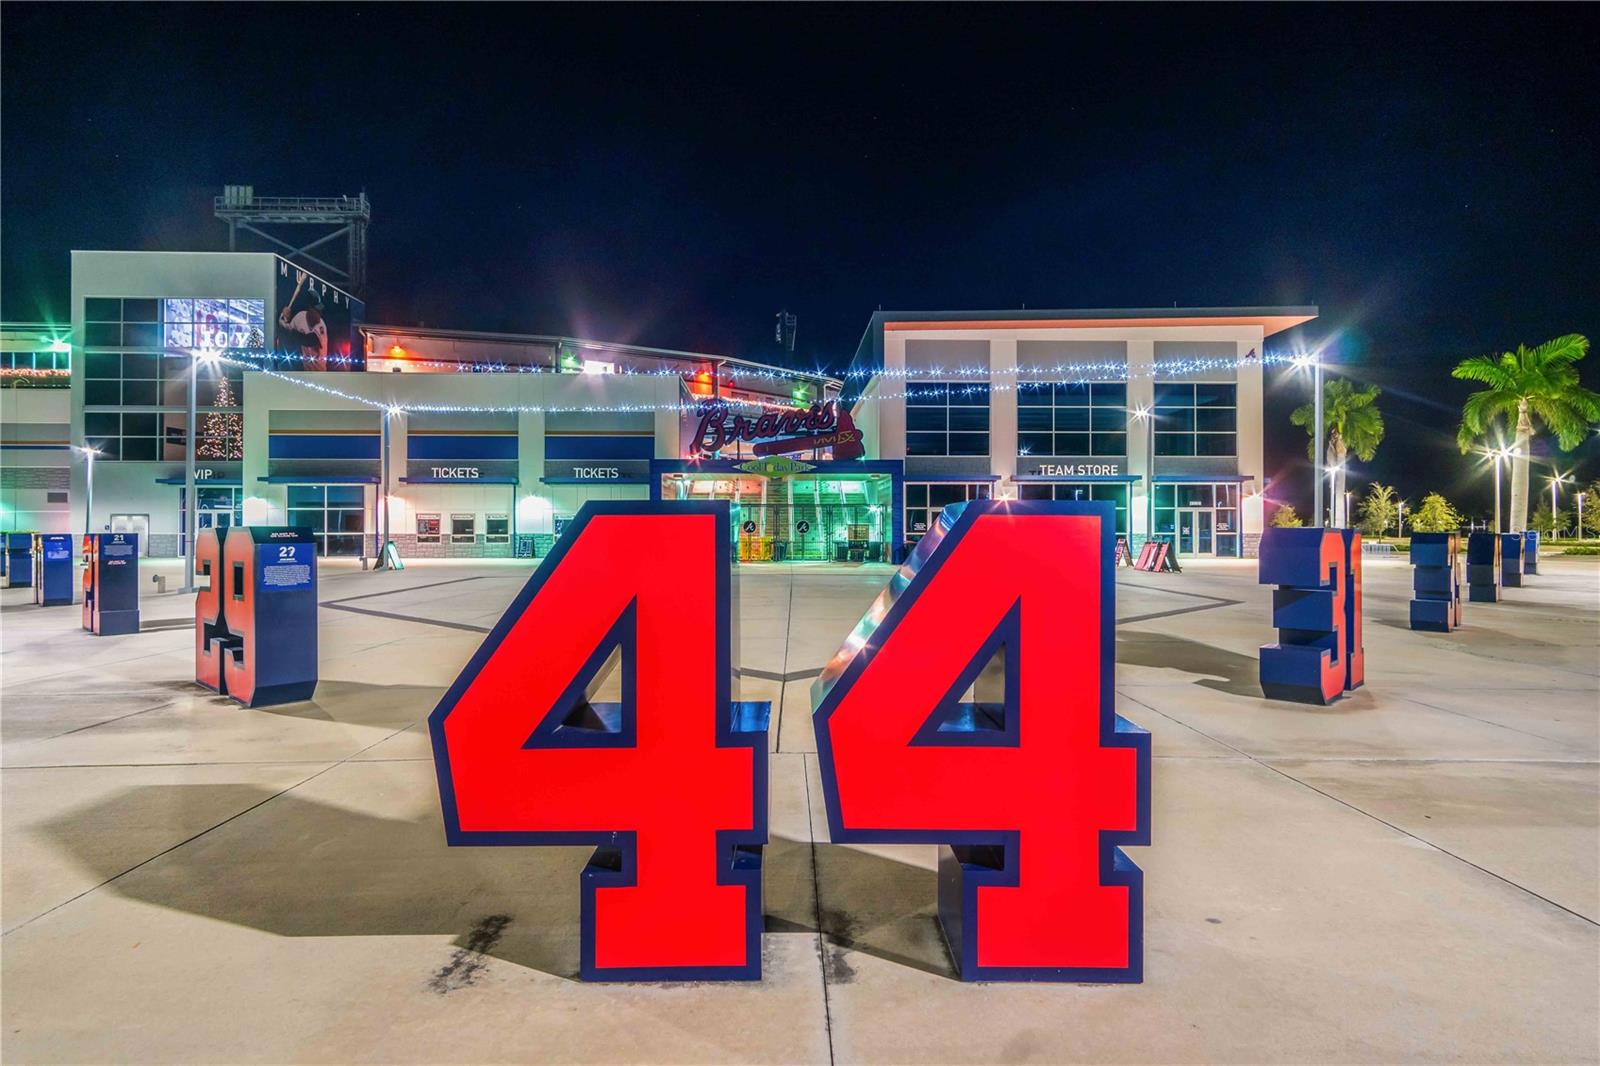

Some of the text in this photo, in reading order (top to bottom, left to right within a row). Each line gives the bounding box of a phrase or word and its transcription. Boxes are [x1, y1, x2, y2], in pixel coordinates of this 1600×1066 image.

[280, 261, 350, 310] MURPHY
[689, 397, 836, 456] Braves
[193, 468, 213, 480] VIP
[431, 466, 480, 479] TICKETS
[573, 466, 619, 479] TICKETS
[1039, 464, 1119, 477] TEAM STORE
